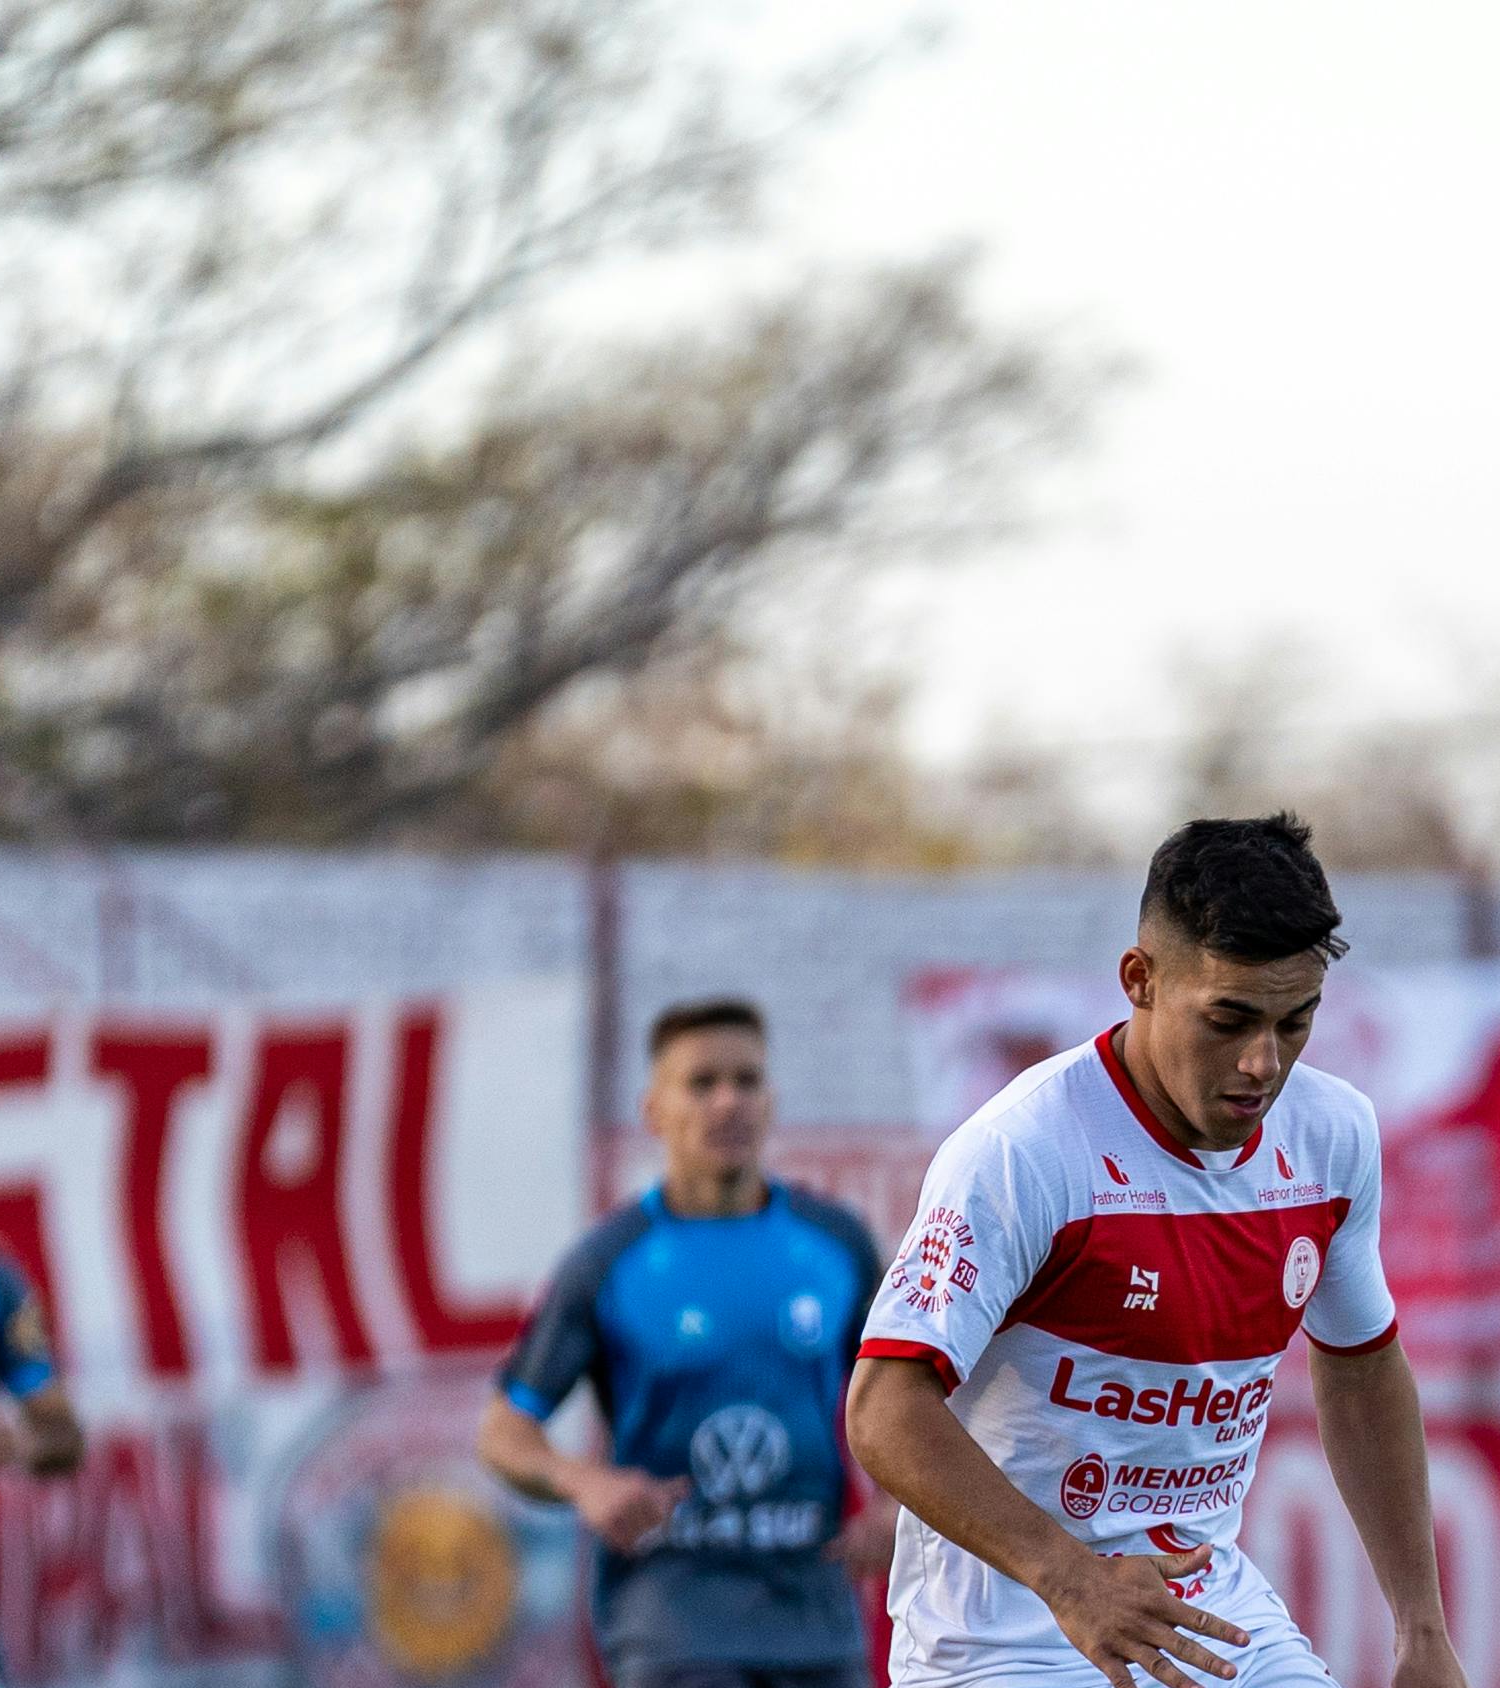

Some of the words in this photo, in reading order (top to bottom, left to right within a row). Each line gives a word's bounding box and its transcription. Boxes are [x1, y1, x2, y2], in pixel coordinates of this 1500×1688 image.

[1128, 1189, 1167, 1204] Hotels
[953, 1260, 977, 1290] 39
[1123, 1293, 1160, 1311] IFK
[1215, 1425, 1236, 1443] tu
[1112, 1452, 1249, 1492] MENDOZA
[1107, 1480, 1245, 1515] GOBIERNO
